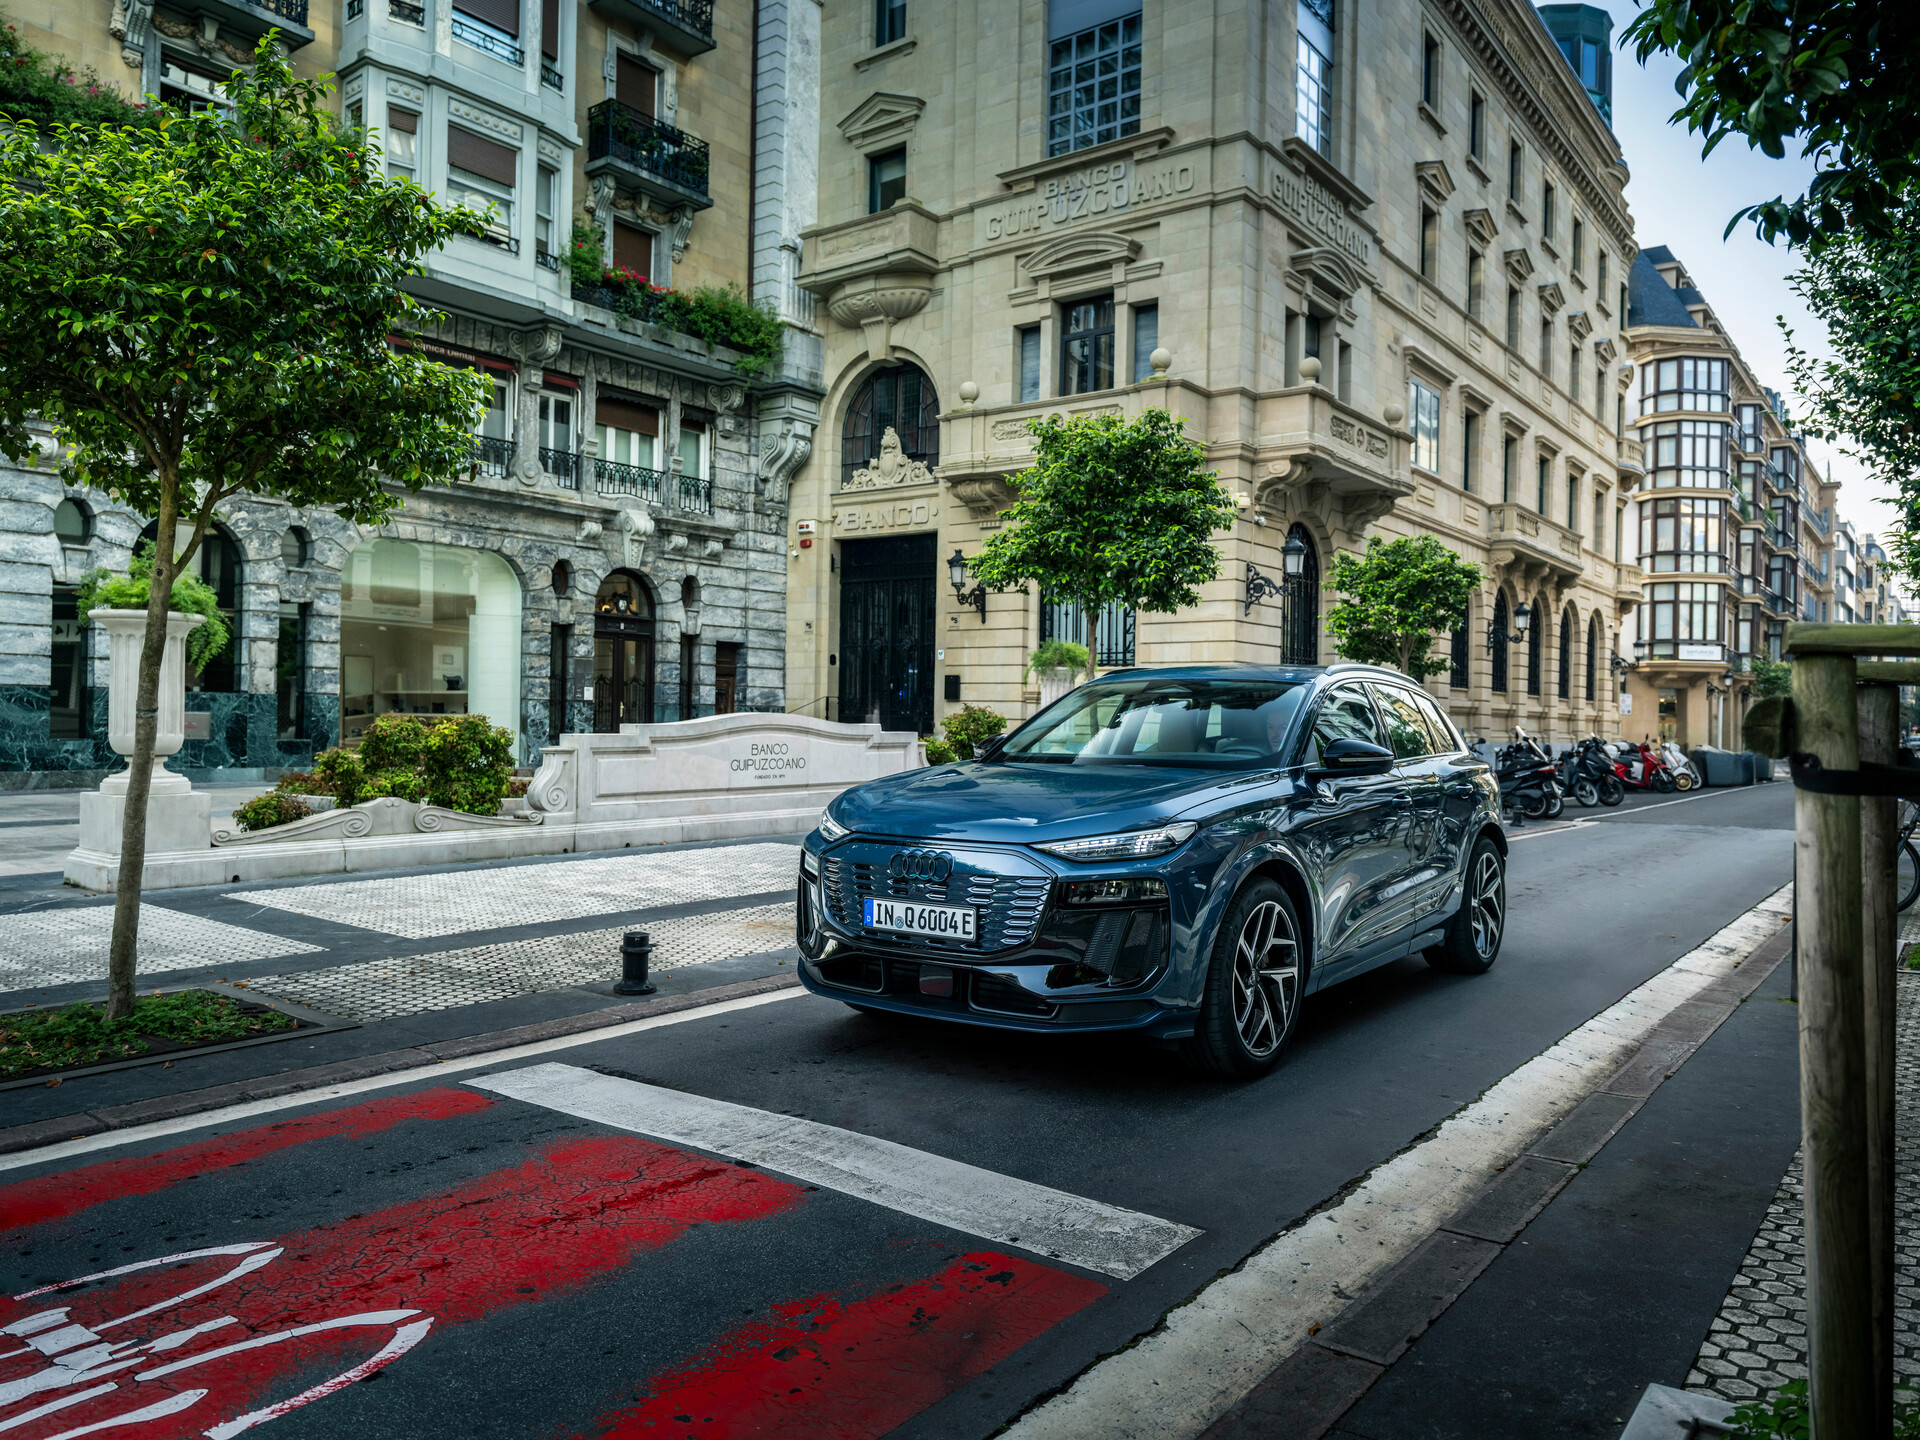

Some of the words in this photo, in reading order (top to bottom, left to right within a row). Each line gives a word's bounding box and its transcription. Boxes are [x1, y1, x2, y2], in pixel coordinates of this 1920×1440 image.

[1044, 161, 1126, 199] BANCO
[1305, 176, 1344, 219] BANCO
[986, 162, 1195, 240] GUIPUZCOANO
[1271, 169, 1369, 266] GUIPUZCOANO
[844, 499, 930, 531] BANCO
[730, 757, 806, 771] GUIPUZCOANO
[751, 743, 788, 755] BANCO
[875, 903, 894, 926] IN
[905, 907, 915, 929] Q
